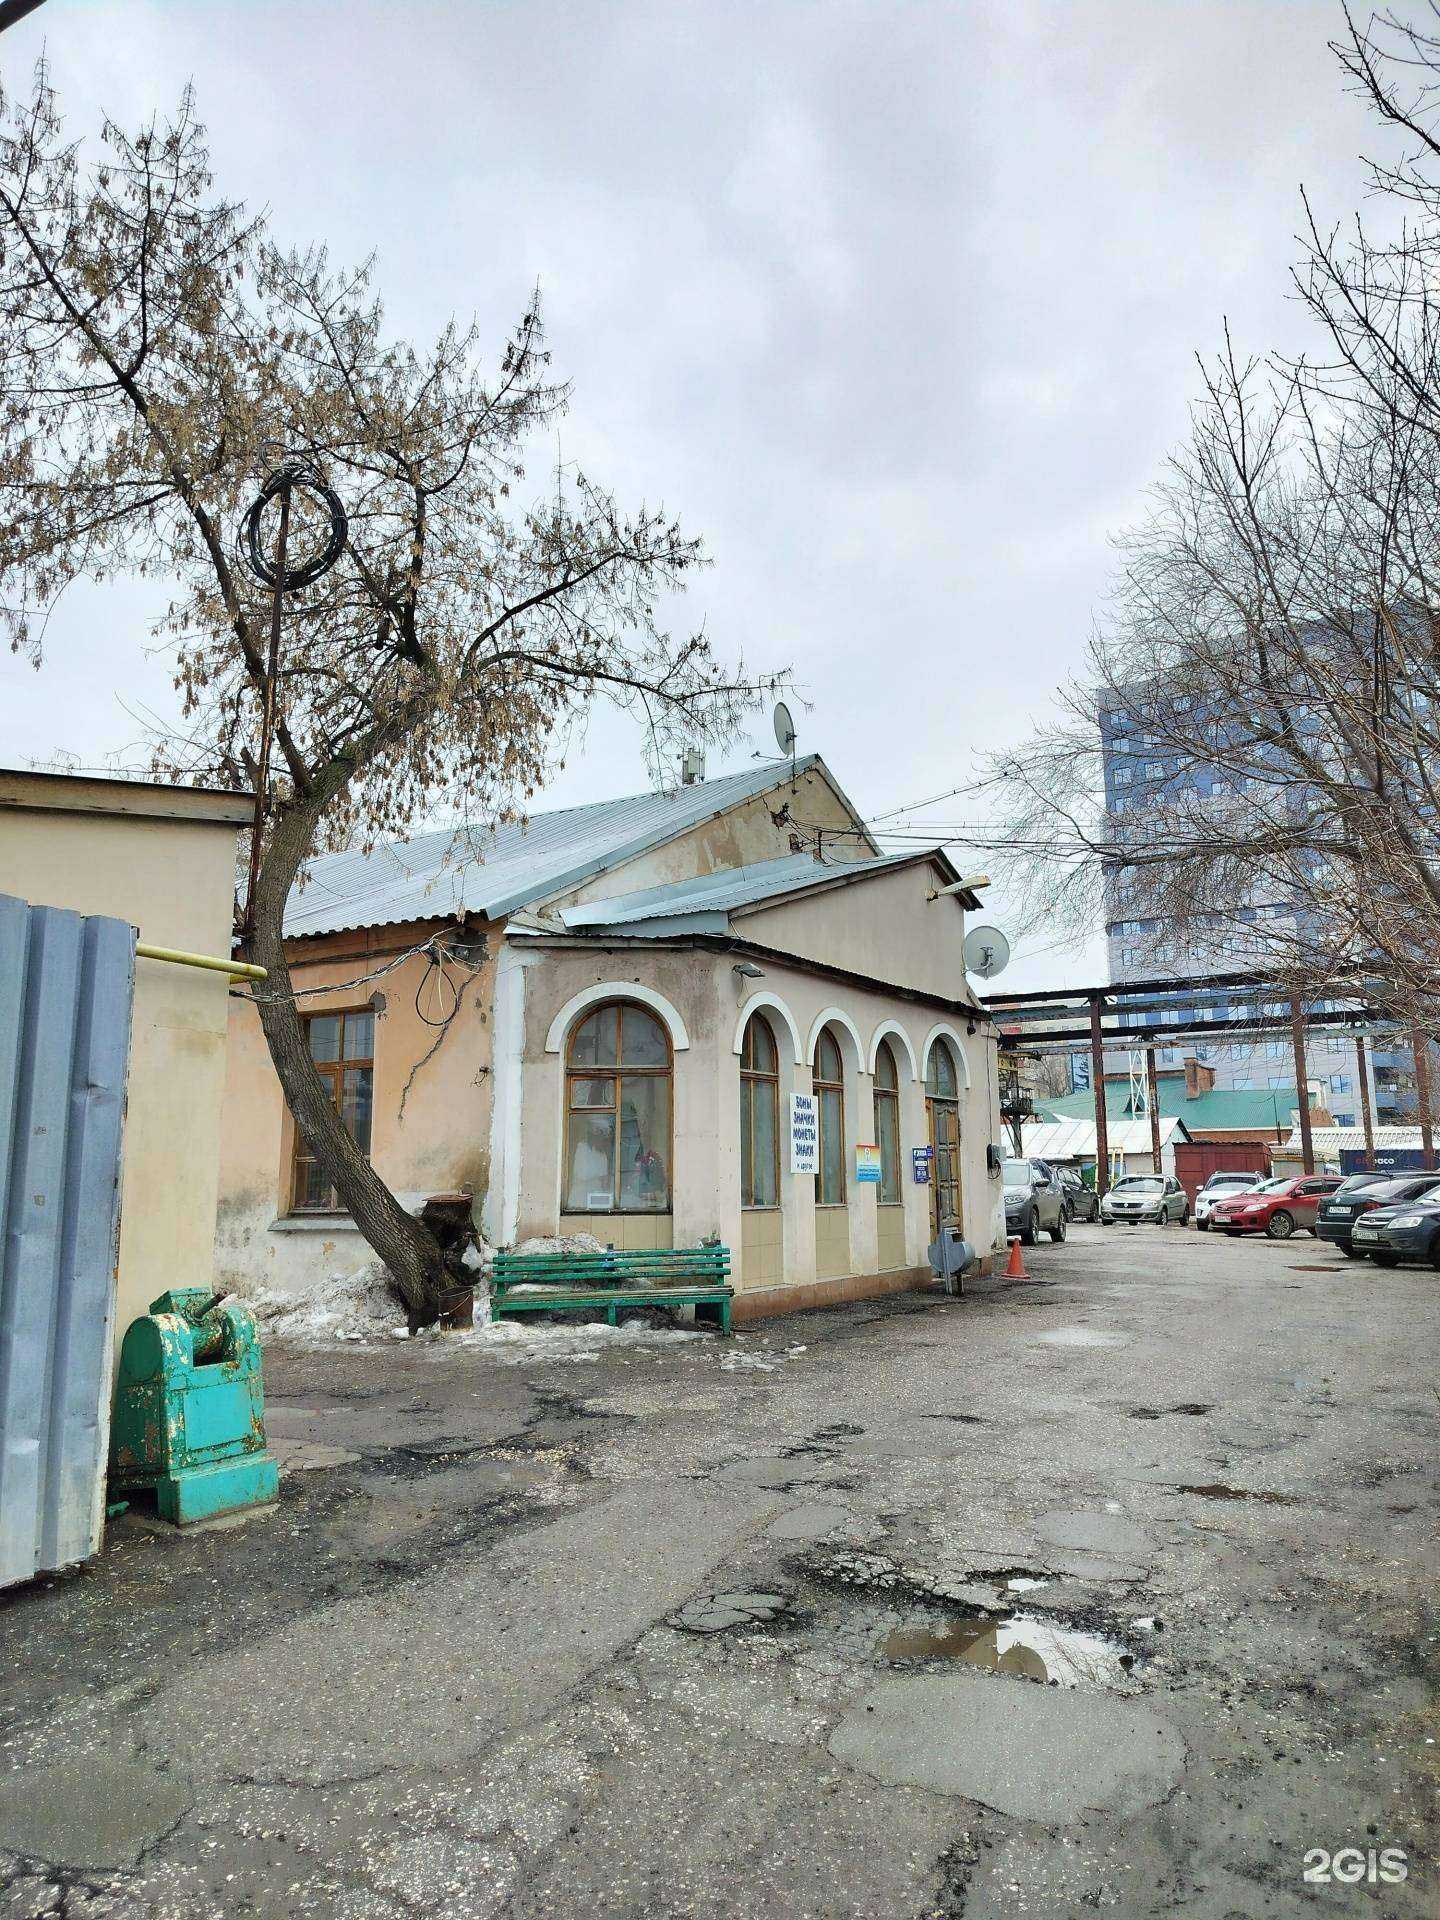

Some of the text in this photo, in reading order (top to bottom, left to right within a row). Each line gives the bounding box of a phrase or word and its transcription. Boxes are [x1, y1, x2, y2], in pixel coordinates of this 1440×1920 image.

[795, 1096, 812, 1110] БОНЫ
[793, 1111, 815, 1126] ЗНАЧКИ
[792, 1127, 816, 1141] МОНЕТЫ
[795, 1143, 814, 1157] ЗНАКИ
